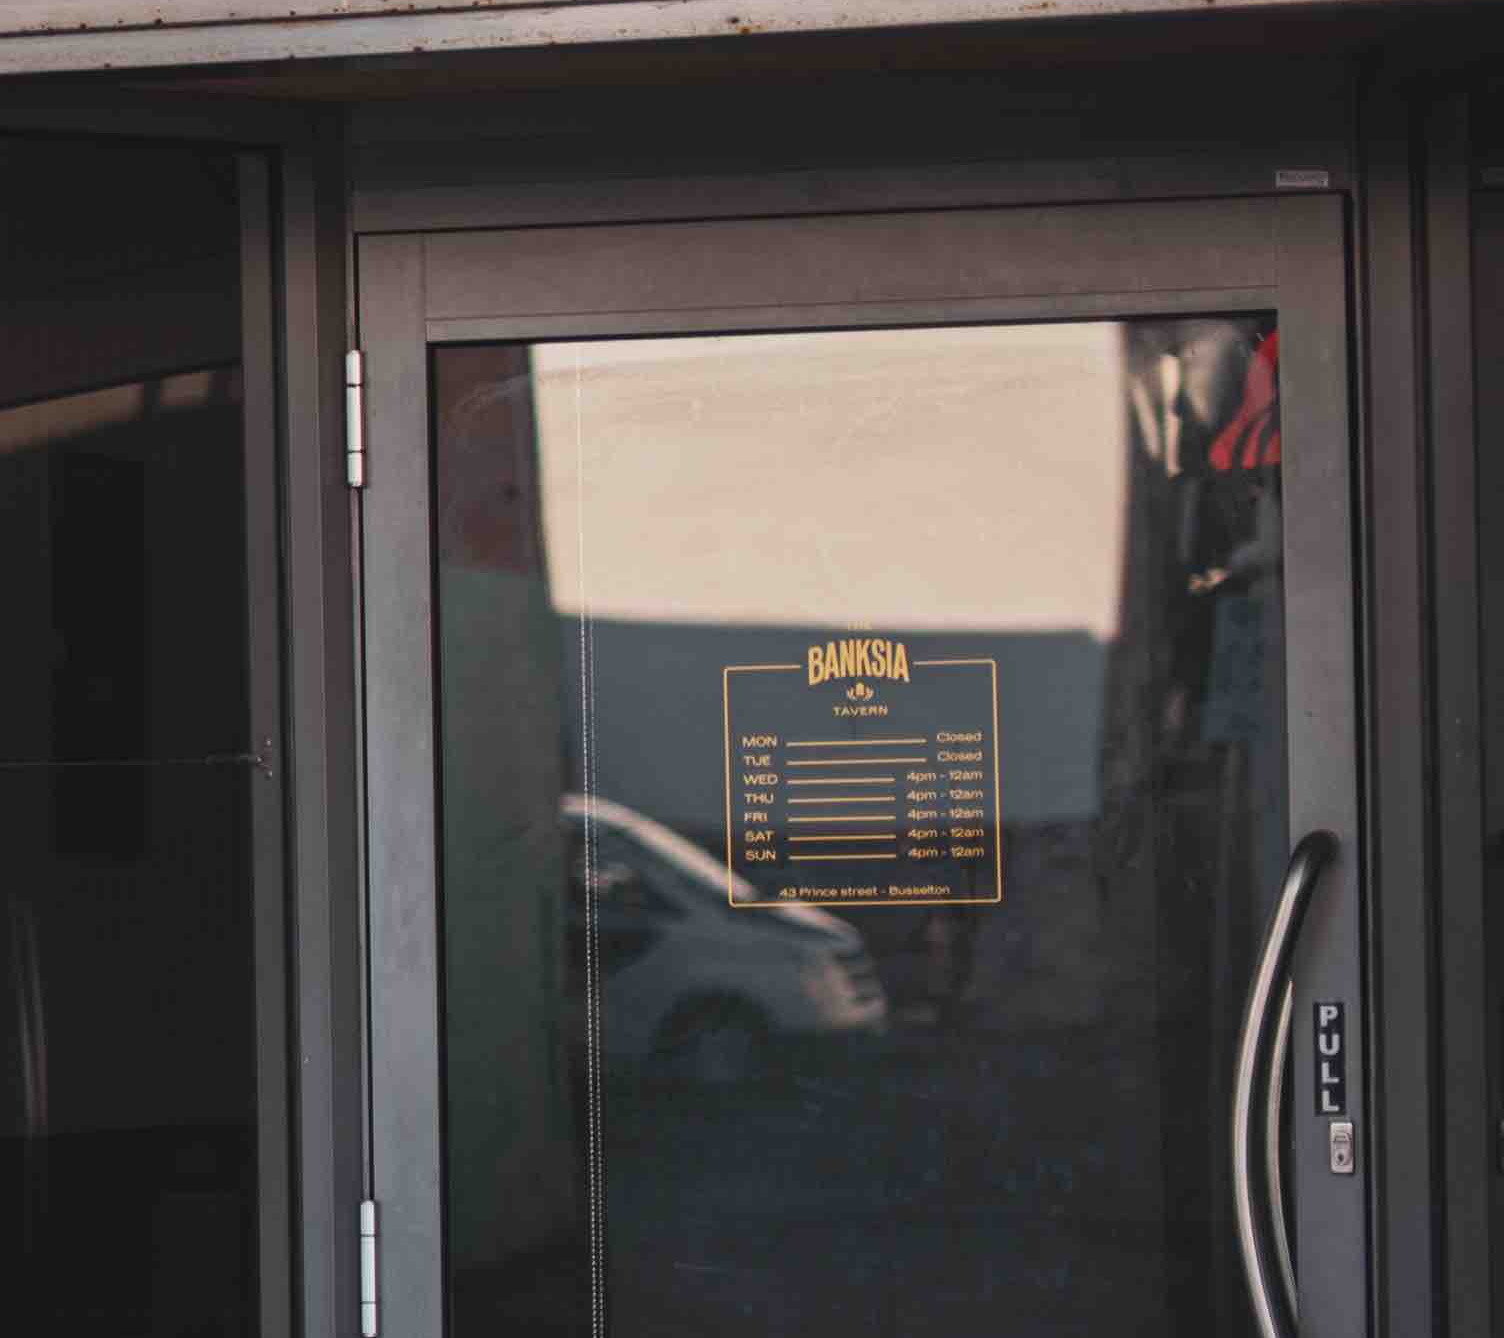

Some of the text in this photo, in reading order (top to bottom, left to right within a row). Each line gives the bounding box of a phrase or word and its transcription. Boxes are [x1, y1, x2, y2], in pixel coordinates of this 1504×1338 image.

[807, 638, 910, 686] BANKSIA
[832, 705, 889, 717] TAVERN
[742, 731, 983, 749] MON Closed
[743, 750, 983, 766] TUE Closed
[743, 773, 779, 785] WED
[906, 771, 937, 784] 4pm
[949, 770, 983, 781] 12am
[744, 793, 775, 804] THU
[907, 790, 937, 802] 4pm
[949, 789, 984, 800] 12am
[744, 812, 768, 822] FRI
[907, 809, 938, 821] 4pm
[949, 808, 984, 819] 12am
[745, 830, 775, 842] SAT
[907, 827, 938, 840] 4pm
[950, 827, 984, 838] 12am
[745, 850, 777, 861] SUN
[908, 847, 938, 859] 4pm
[951, 846, 985, 858] 12am
[799, 886, 838, 898] Prince
[840, 886, 879, 897] street
[888, 884, 951, 896] Busselton
[1318, 1005, 1341, 1112] PULL
